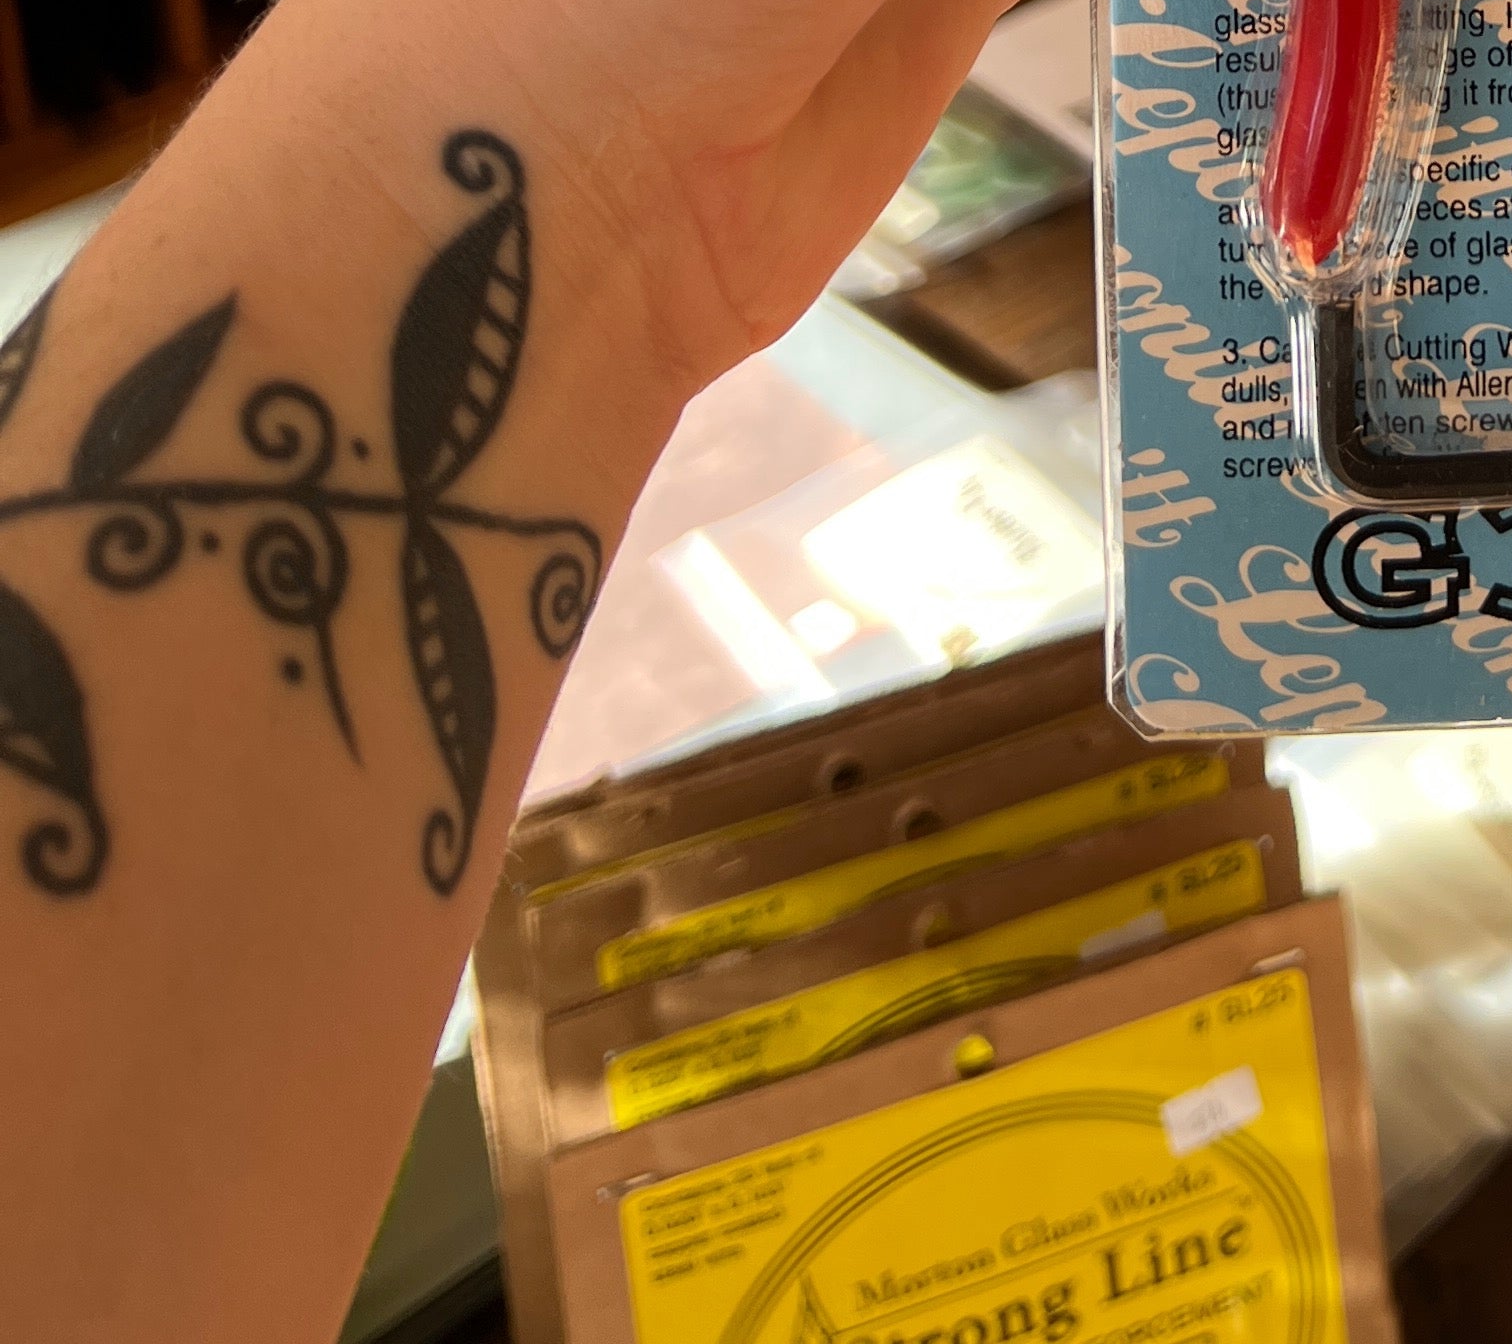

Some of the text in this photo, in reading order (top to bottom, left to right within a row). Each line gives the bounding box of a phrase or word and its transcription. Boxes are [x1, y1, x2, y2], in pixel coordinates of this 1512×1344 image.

[1462, 80, 1479, 106] it
[1429, 230, 1458, 258] of
[1219, 268, 1490, 304] the shape.
[1221, 336, 1249, 365] 3.
[1384, 331, 1487, 365] Cutting
[1220, 374, 1289, 406] dulls,
[1396, 370, 1447, 399] with
[1222, 413, 1275, 441] and
[1098, 1215, 1250, 1309] Line
